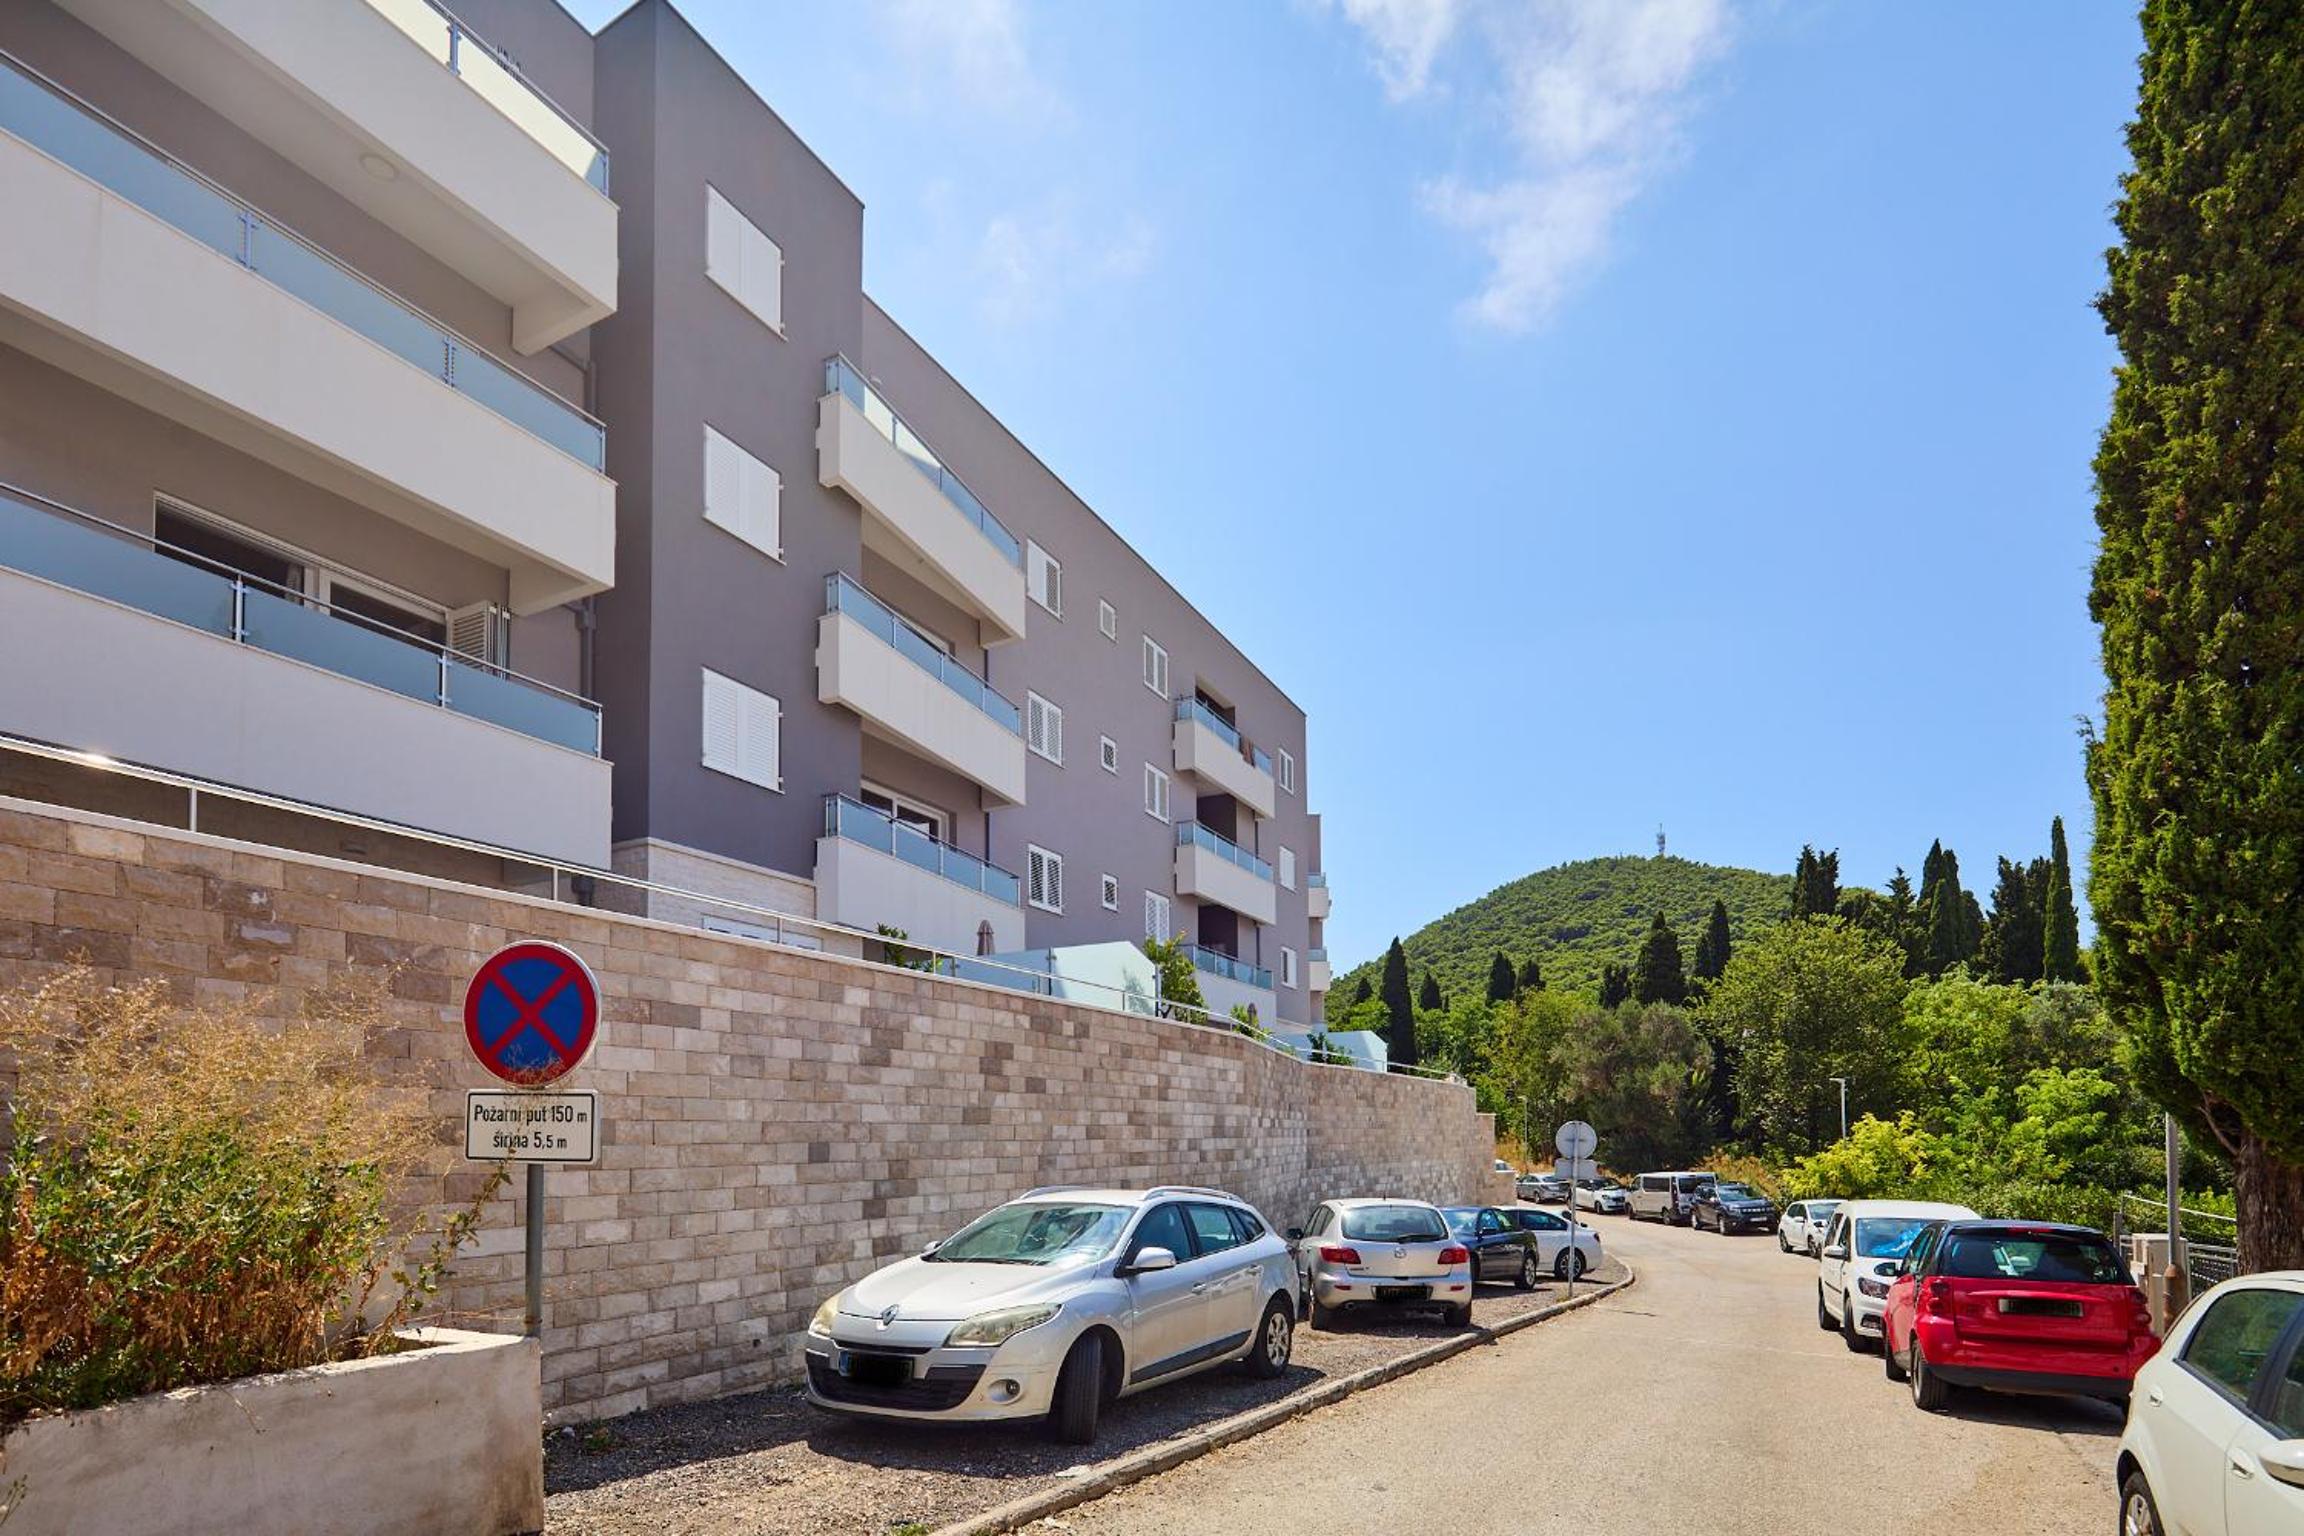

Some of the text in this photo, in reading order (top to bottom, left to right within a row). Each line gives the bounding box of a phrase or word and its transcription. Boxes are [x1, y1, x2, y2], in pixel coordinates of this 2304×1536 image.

[474, 1104, 588, 1126] Požarni put 150 m
[533, 1131, 554, 1149] 5,5
[557, 1137, 568, 1149] m
